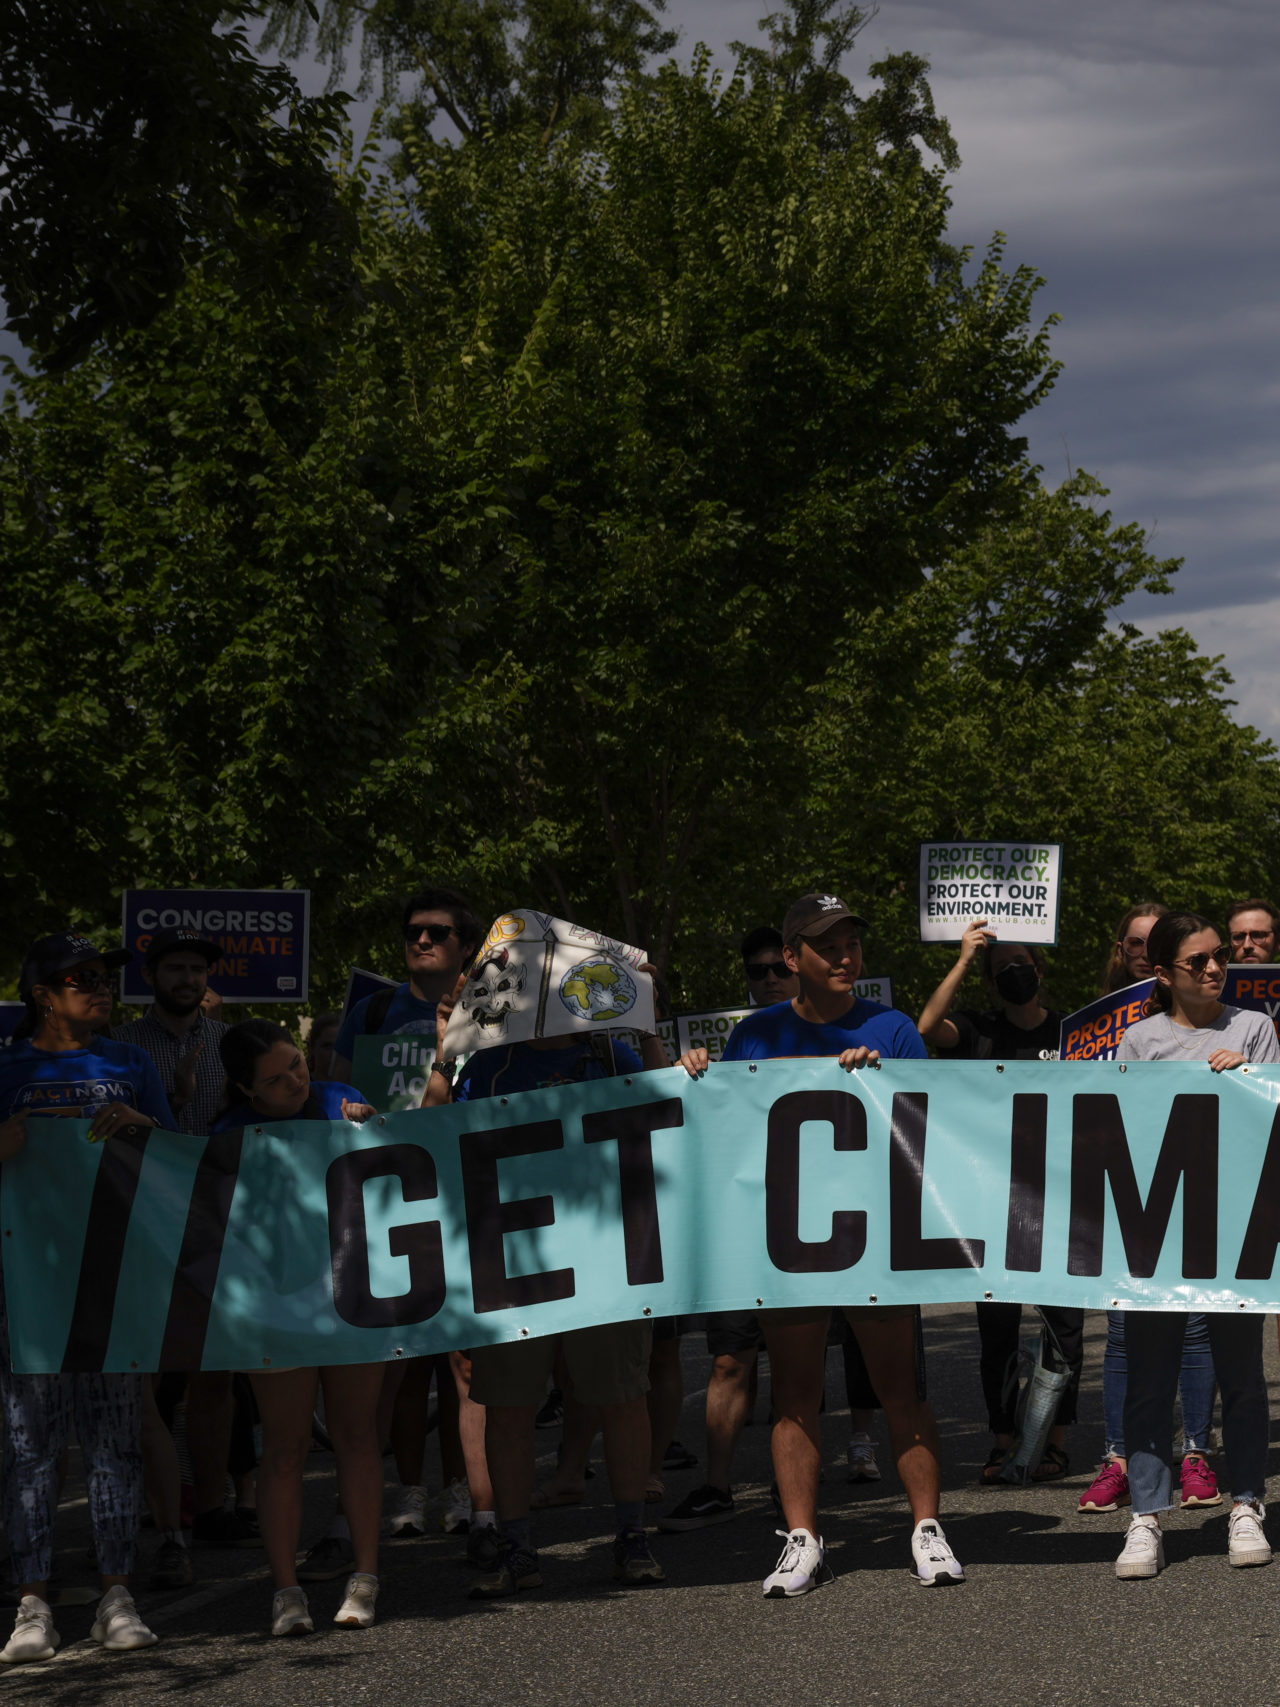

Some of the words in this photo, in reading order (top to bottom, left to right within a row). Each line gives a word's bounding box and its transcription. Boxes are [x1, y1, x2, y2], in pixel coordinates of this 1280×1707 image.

[928, 847, 1006, 863] PROTECT
[1010, 848, 1049, 864] OUR
[927, 864, 1050, 882] DEMOCRACY.
[927, 884, 1003, 899] PROTECT
[1008, 884, 1048, 900] OUR
[927, 901, 1048, 918] ENVIRONMENT.
[136, 908, 294, 933] CONGRESS
[22, 1083, 125, 1104] #ACTNOW
[325, 1097, 684, 1329] GET
